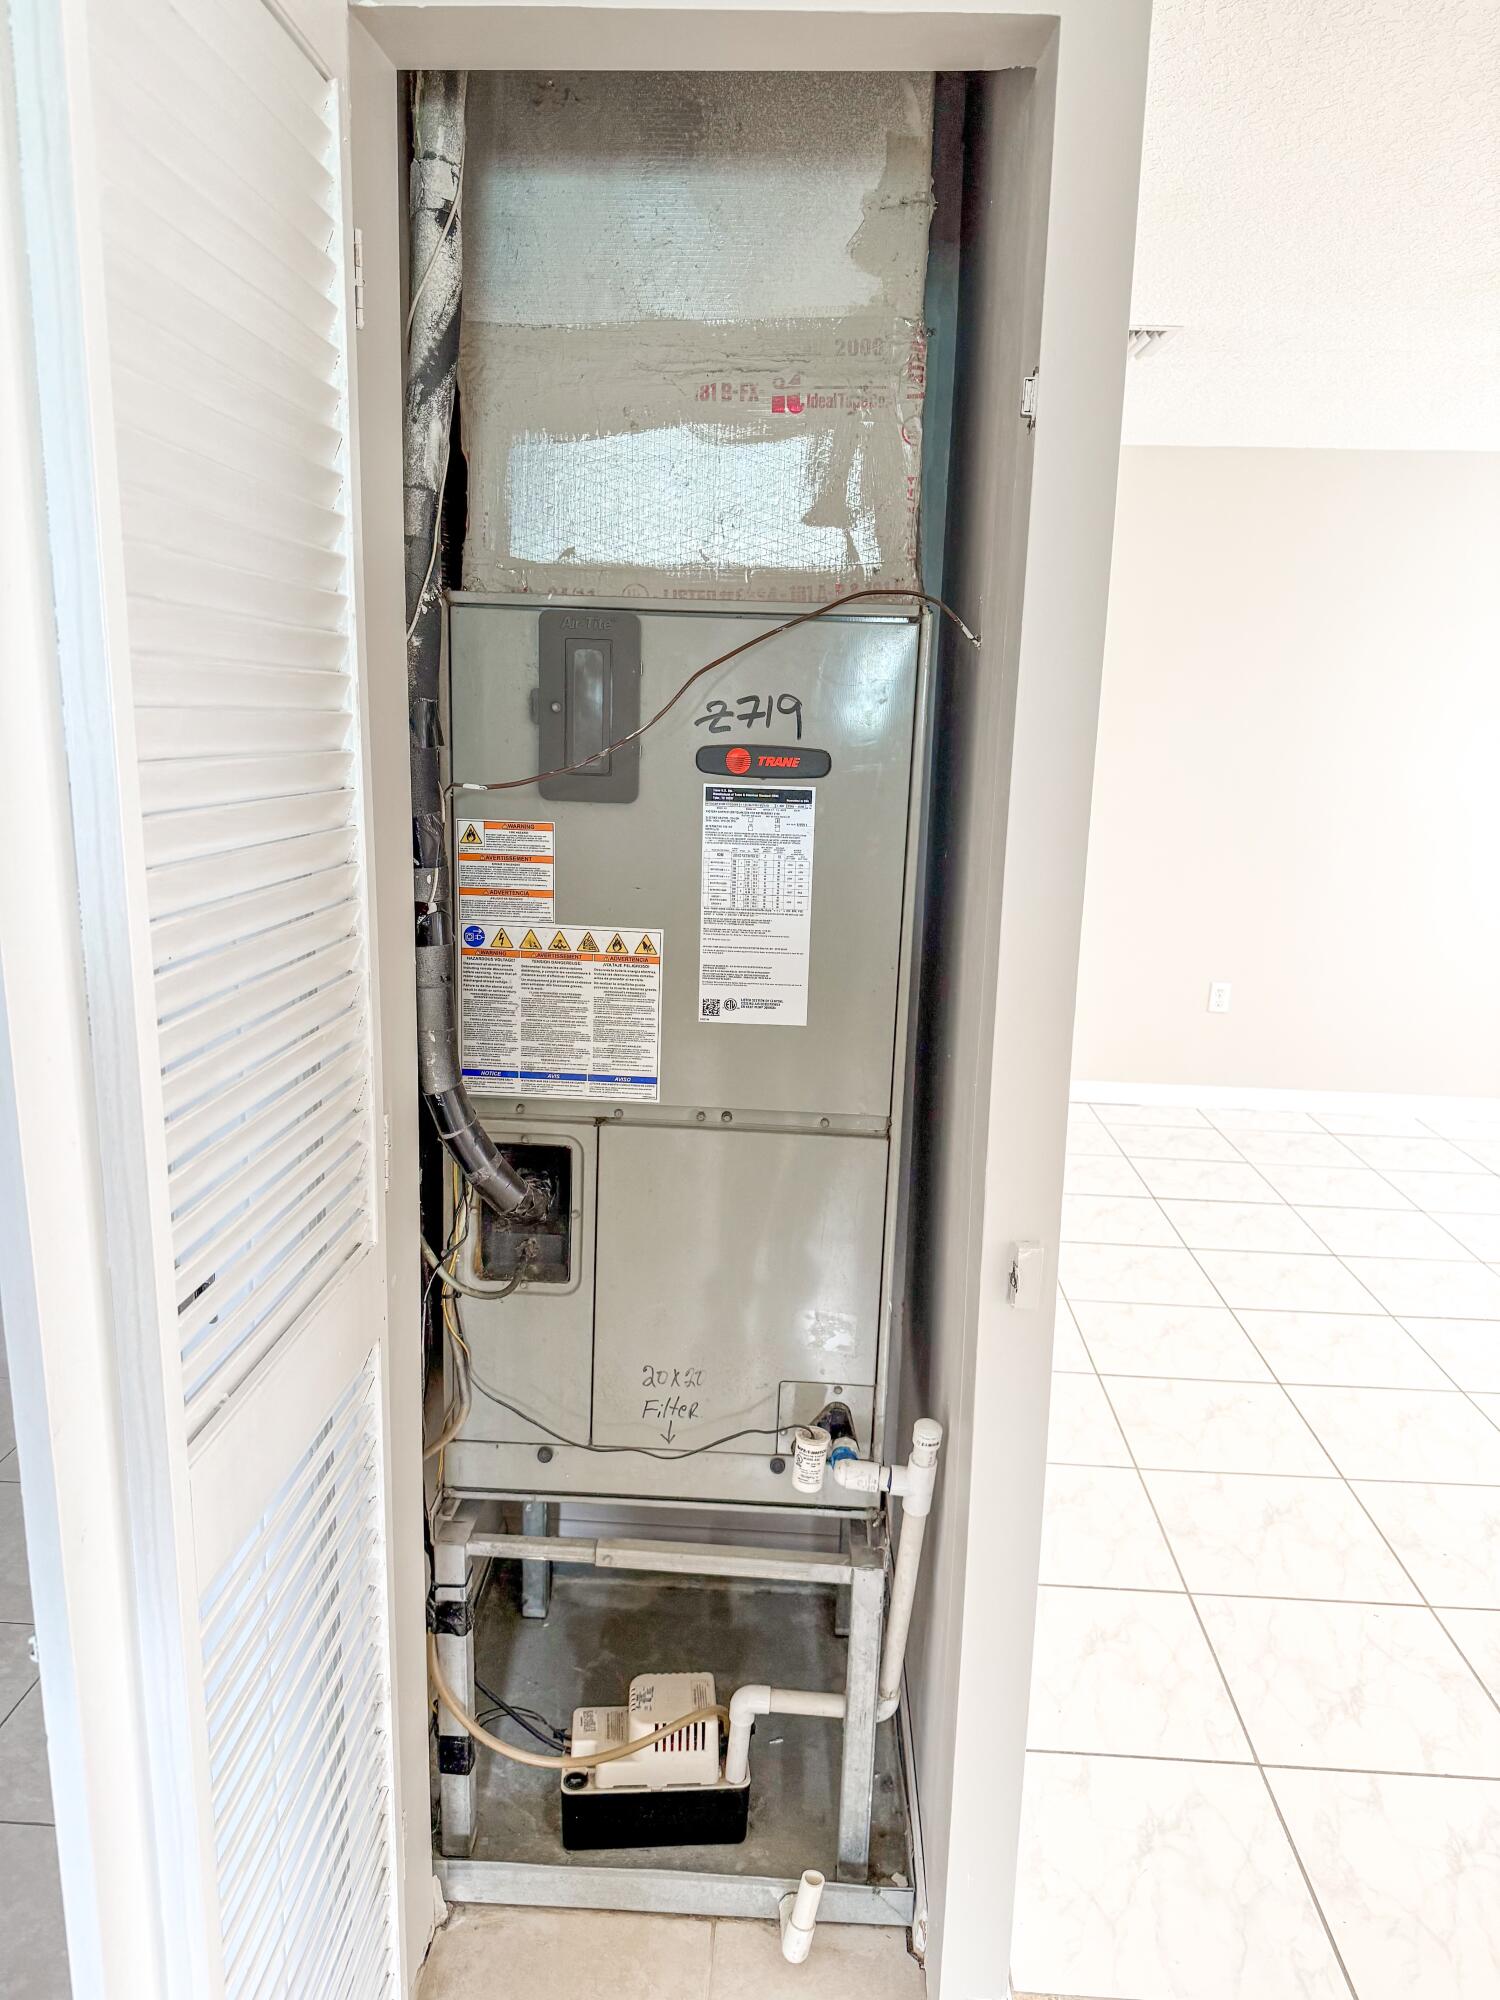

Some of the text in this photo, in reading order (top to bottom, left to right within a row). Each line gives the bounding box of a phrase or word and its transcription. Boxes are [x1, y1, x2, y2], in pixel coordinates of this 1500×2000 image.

[806, 392, 836, 409] Ideal
[757, 756, 801, 768] TRANE
[485, 855, 532, 863] AVERTISSEMENT
